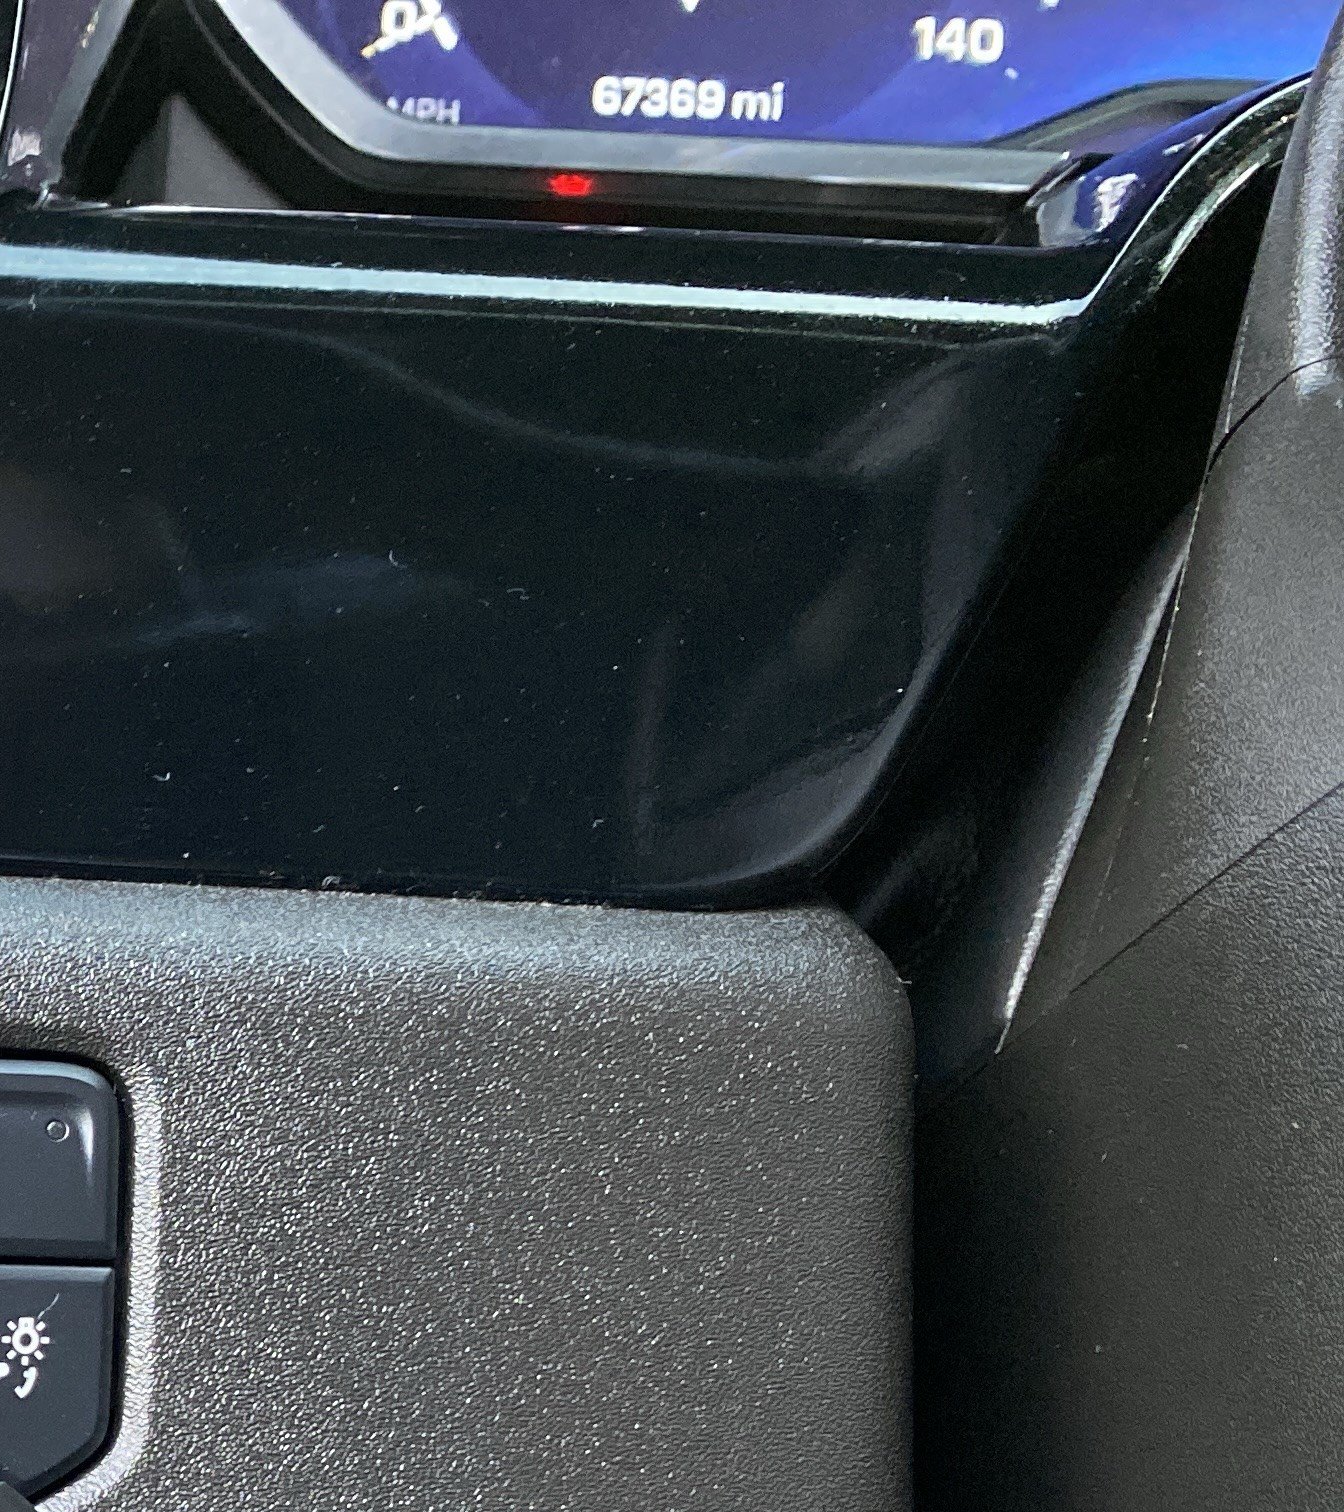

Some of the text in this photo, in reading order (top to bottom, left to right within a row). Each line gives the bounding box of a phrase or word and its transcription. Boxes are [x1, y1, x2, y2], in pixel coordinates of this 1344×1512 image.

[913, 16, 1005, 64] 140
[592, 75, 785, 121] 67369 mi
